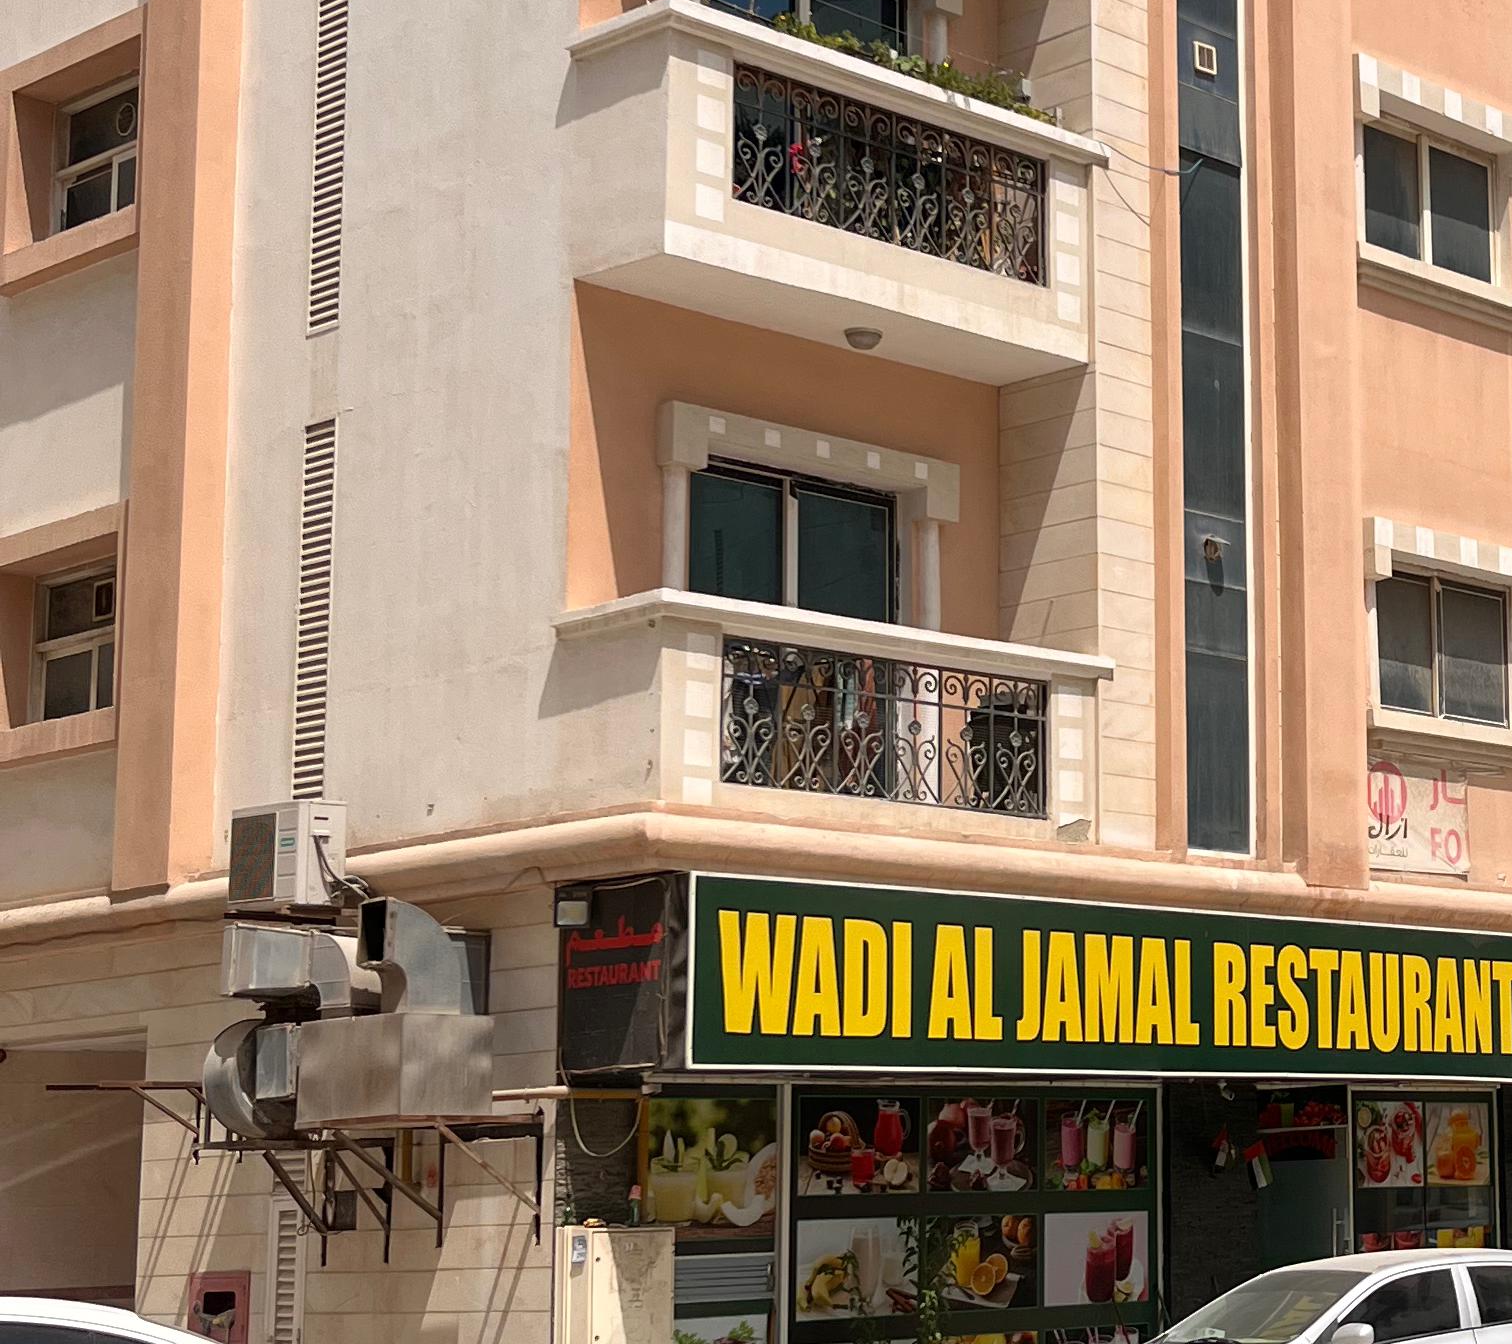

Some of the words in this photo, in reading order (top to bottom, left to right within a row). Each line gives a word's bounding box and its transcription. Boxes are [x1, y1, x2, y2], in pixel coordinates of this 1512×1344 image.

[1430, 827, 1469, 865] FO
[566, 915, 664, 967] مطعم
[567, 958, 662, 990] RESTAURANT
[718, 908, 913, 1039] WADI
[927, 923, 1004, 1040] AL
[1016, 928, 1200, 1045] JAMAL
